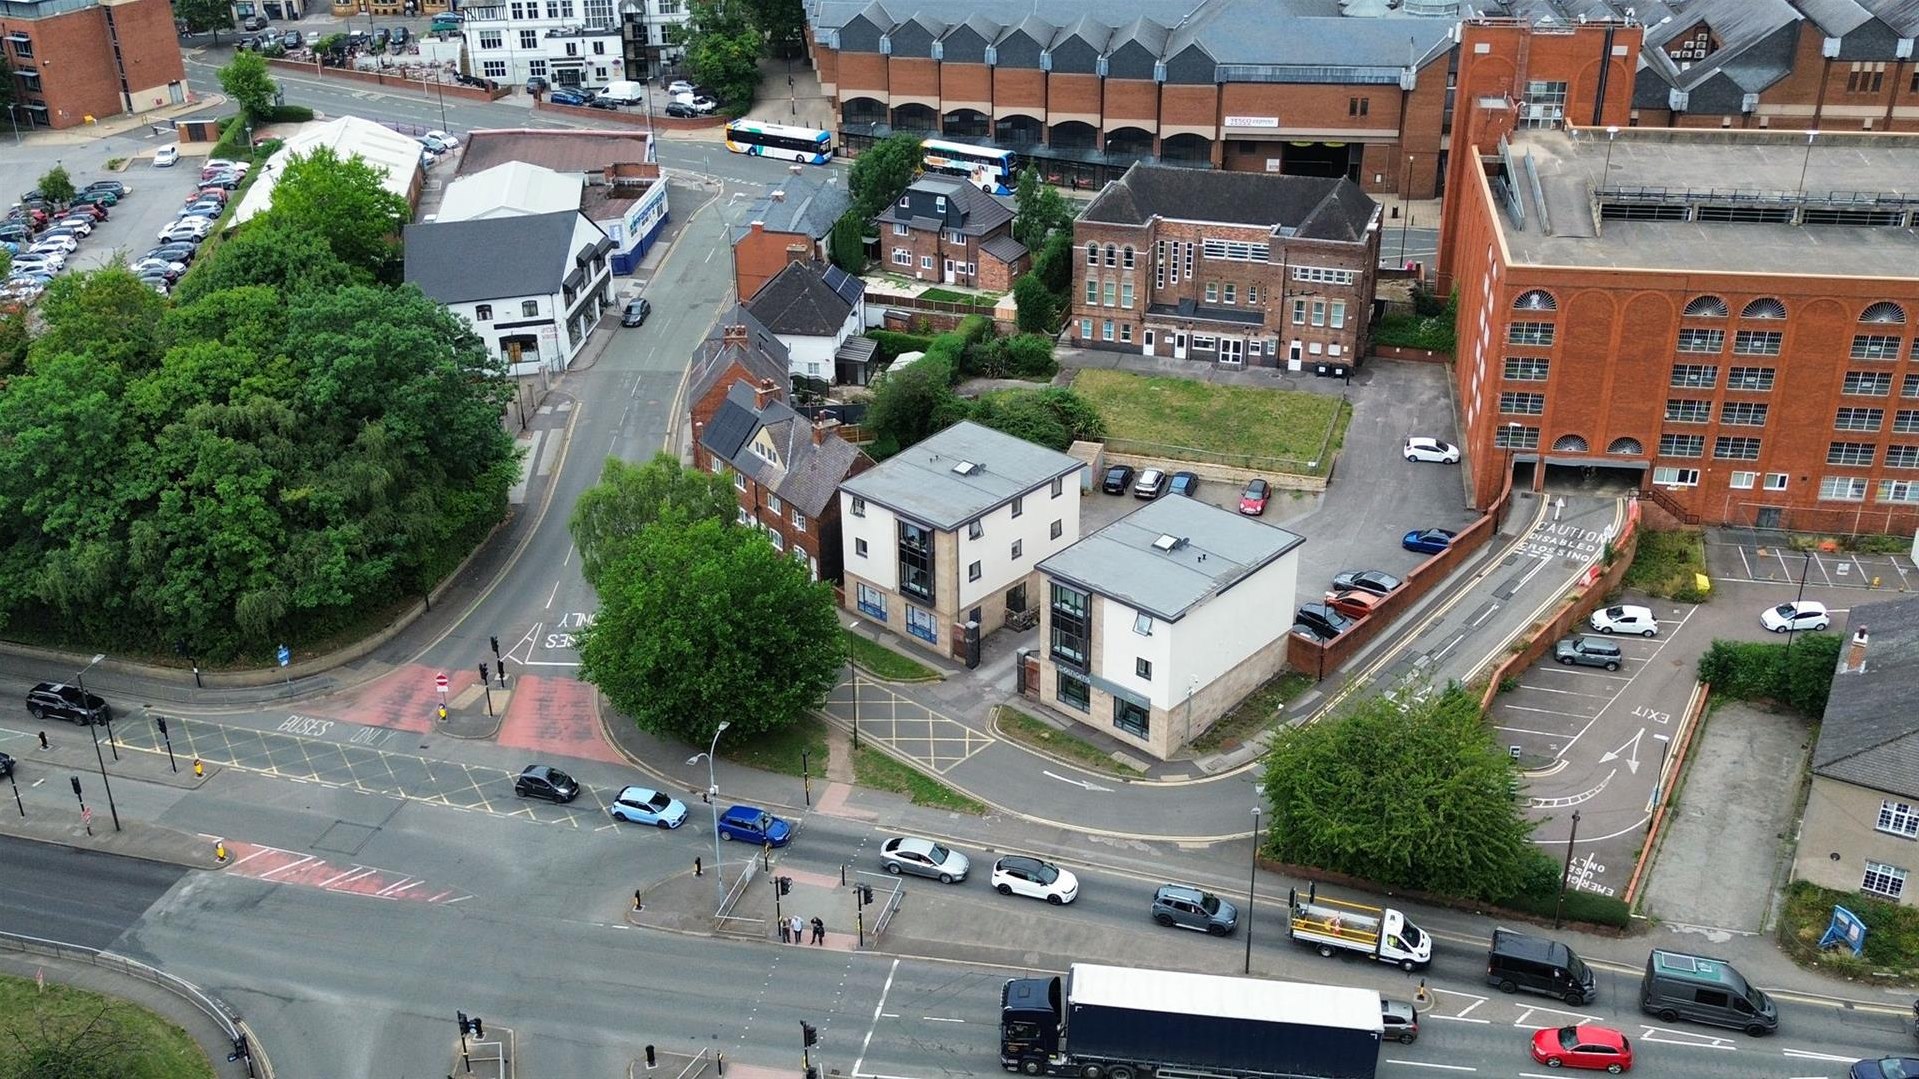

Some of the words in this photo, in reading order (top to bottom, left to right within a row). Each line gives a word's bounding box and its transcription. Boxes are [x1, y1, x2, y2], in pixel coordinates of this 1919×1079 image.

[1537, 521, 1610, 543] CAUTION
[1518, 541, 1590, 562] CROSSING
[1529, 533, 1595, 552] DISABLED
[1631, 706, 1670, 724] EXIT
[277, 715, 334, 736] BUSES
[350, 726, 396, 747] ONLY
[1570, 857, 1605, 873] ONLY
